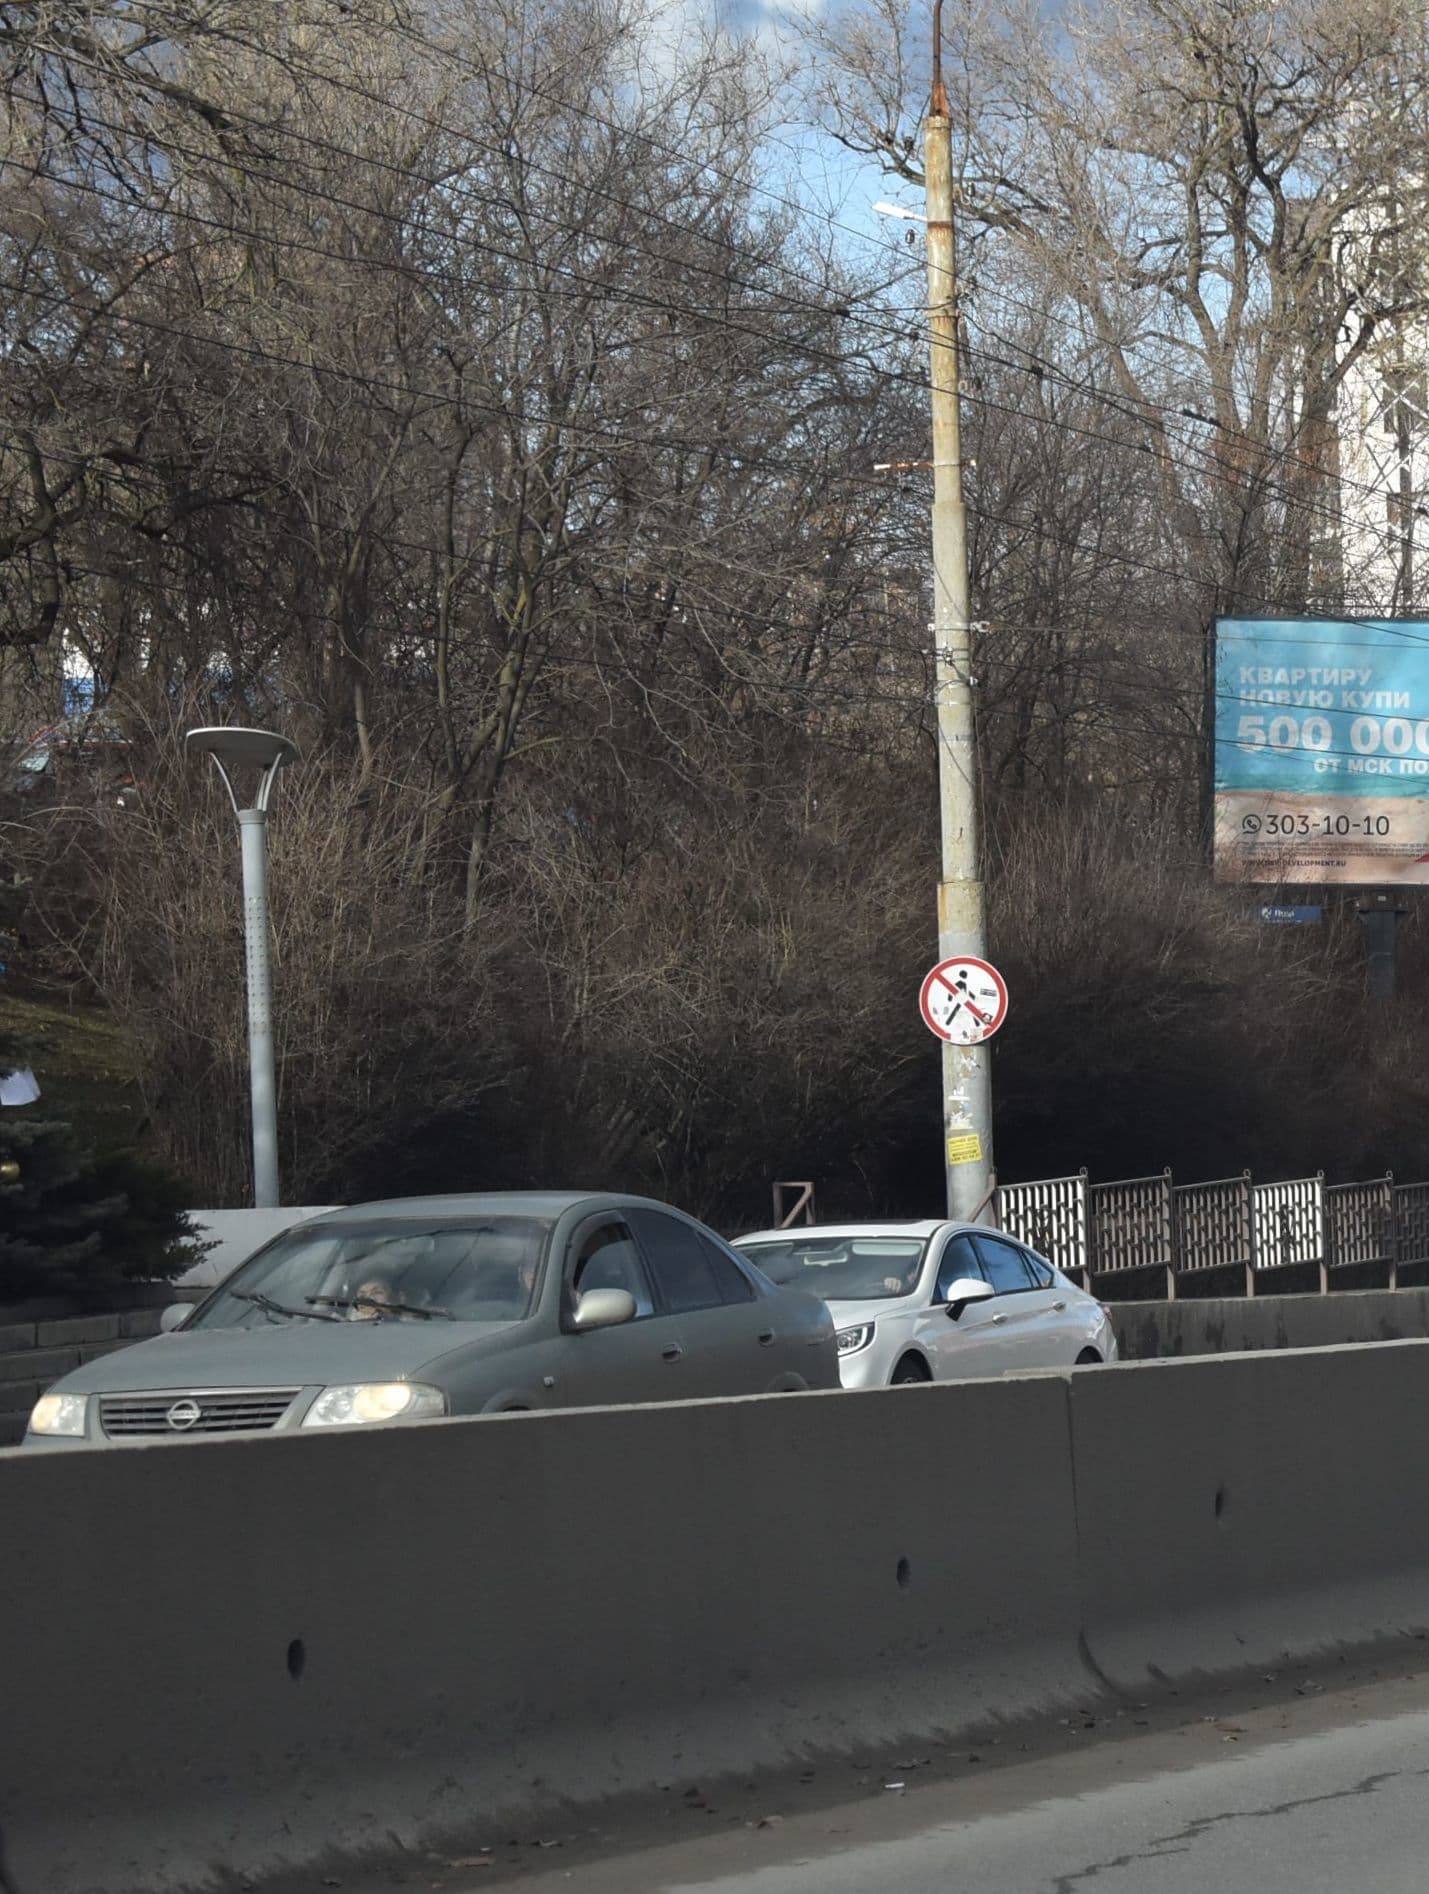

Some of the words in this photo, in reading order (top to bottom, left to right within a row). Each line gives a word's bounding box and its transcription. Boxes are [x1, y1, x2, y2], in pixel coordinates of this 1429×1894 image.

[1239, 667, 1372, 685] КВАРТИРУ
[1239, 690, 1334, 707] НОВУЮ
[1342, 691, 1411, 709] КУПИ
[1236, 716, 1333, 754] 500
[1314, 758, 1341, 773] ОТ
[1349, 758, 1393, 774] МСК
[1266, 814, 1391, 836] 303-10-10
